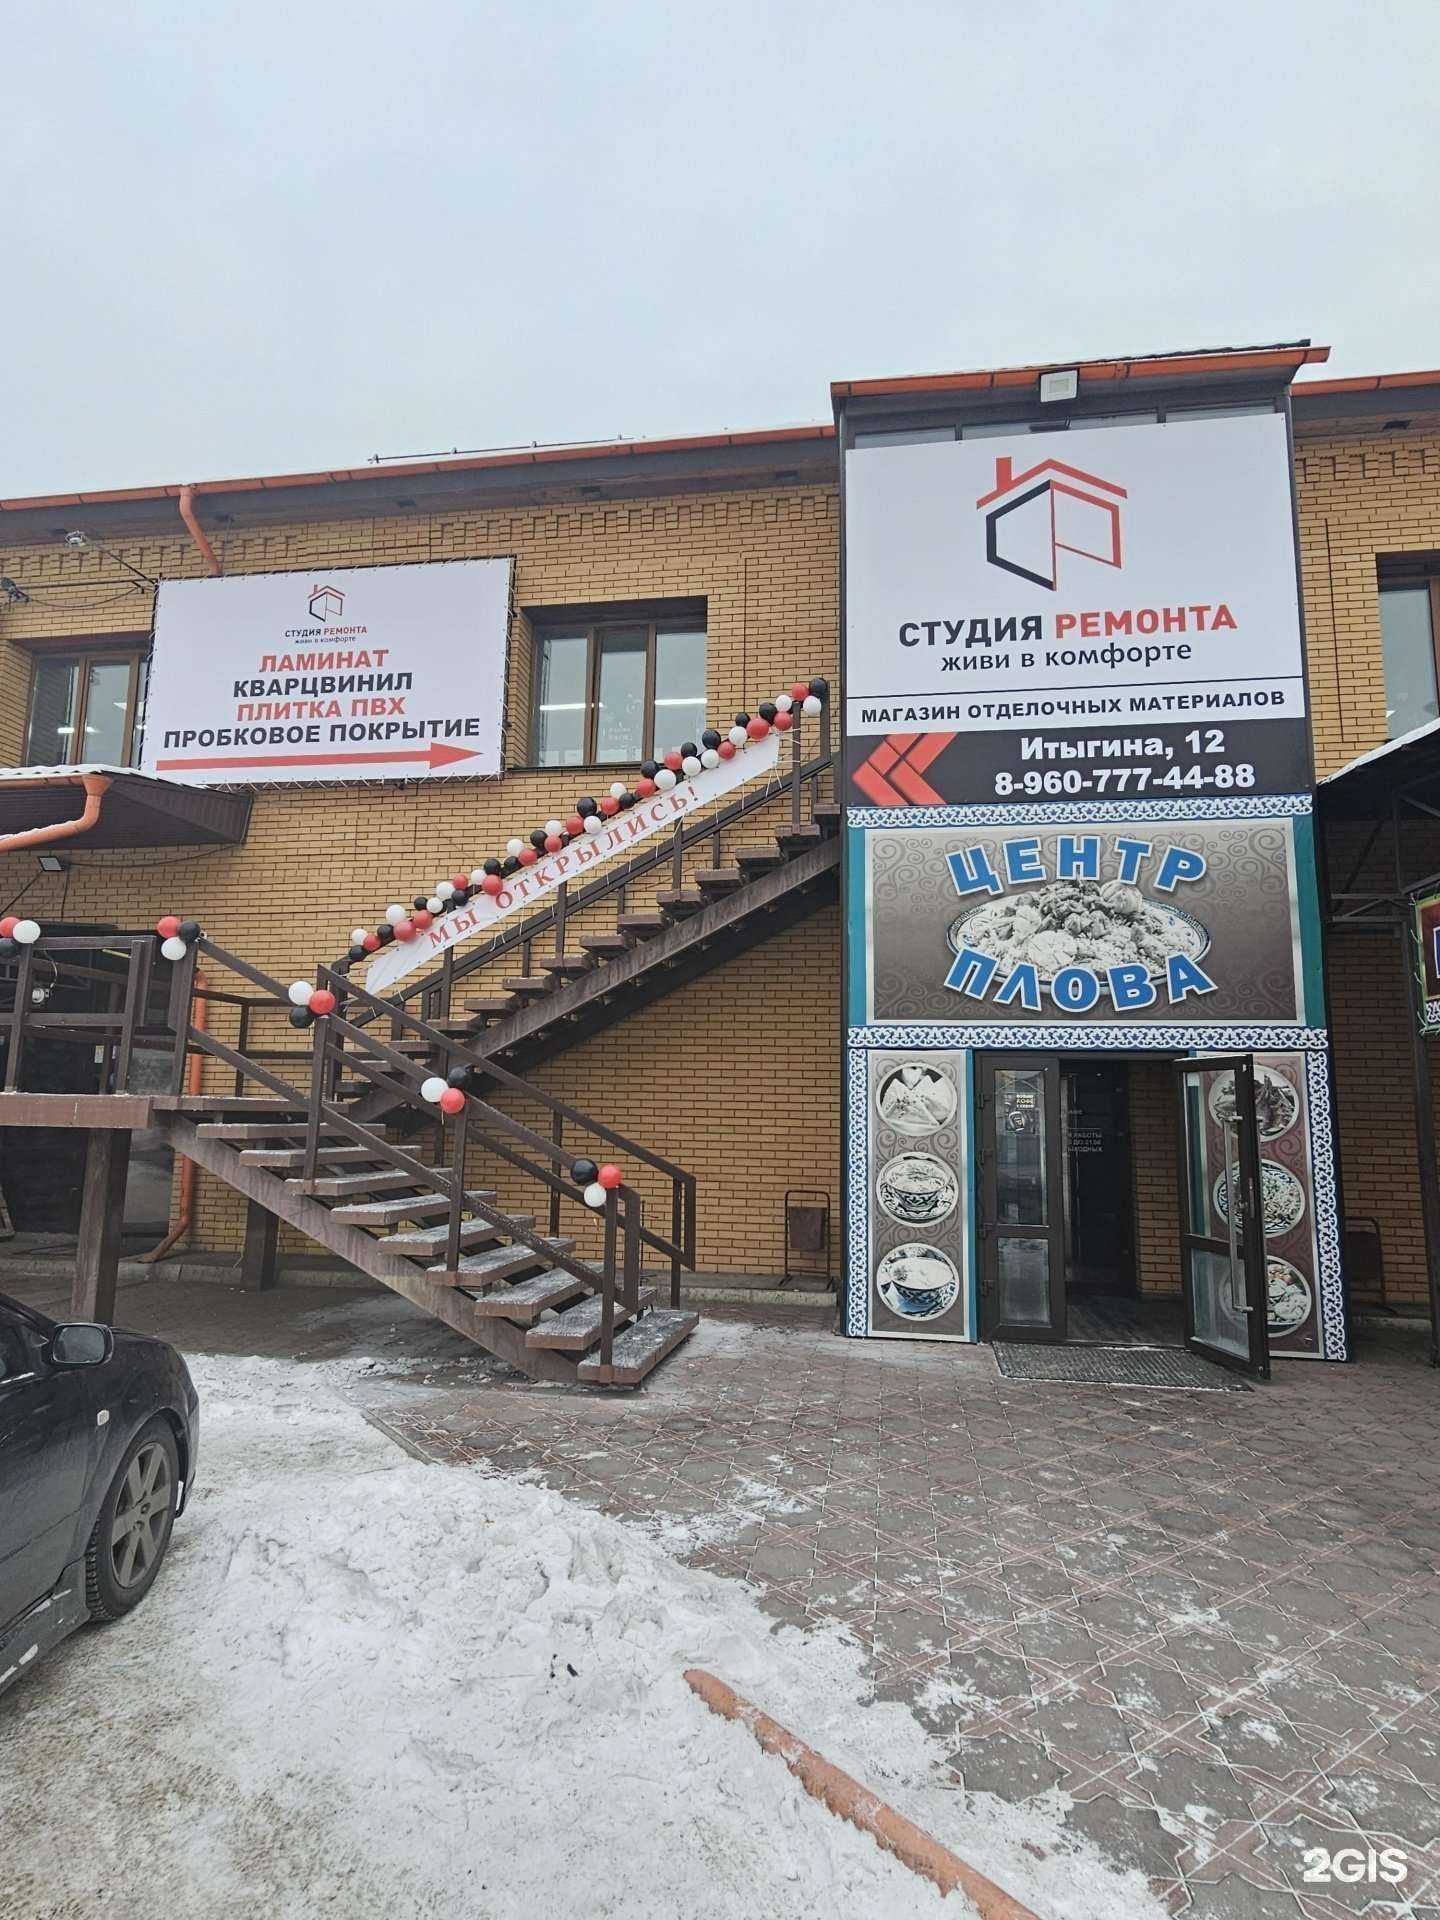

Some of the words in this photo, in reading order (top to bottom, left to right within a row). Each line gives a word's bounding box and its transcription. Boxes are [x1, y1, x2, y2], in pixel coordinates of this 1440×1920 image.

[285, 628, 321, 637] СТУДИЯ
[324, 626, 367, 635] РЕМОНТА
[899, 615, 1043, 648] СТУДИЯ
[1056, 604, 1238, 639] РЕМОНТА
[259, 649, 389, 673] ЛАМИНАТ
[941, 651, 1011, 672] живи
[1020, 652, 1035, 668] в
[1045, 642, 1192, 670] комфорте
[233, 672, 413, 698] КВАРЦВИНИЛ
[236, 700, 342, 722] ПЛИТКА
[351, 697, 406, 718] ПВХ
[861, 704, 960, 723] МАГАЗИН
[967, 697, 1122, 721] ОТДЕЛОЧНЫХ
[1129, 690, 1286, 713] МАТЕРИАЛОВ
[163, 724, 320, 749] ПРОБКОВОЕ
[329, 718, 480, 742] ПОКРЫТИЕ
[1020, 735, 1174, 761] Итыгина,
[1184, 729, 1225, 754] 12
[994, 763, 1256, 796] 8-960-777-44-88
[429, 909, 481, 949] МЫ
[495, 785, 699, 911] ОТКРЫЛИСЬ!
[945, 835, 1207, 896] ЦЕНТР
[943, 946, 1218, 1013] ПЛОВА
